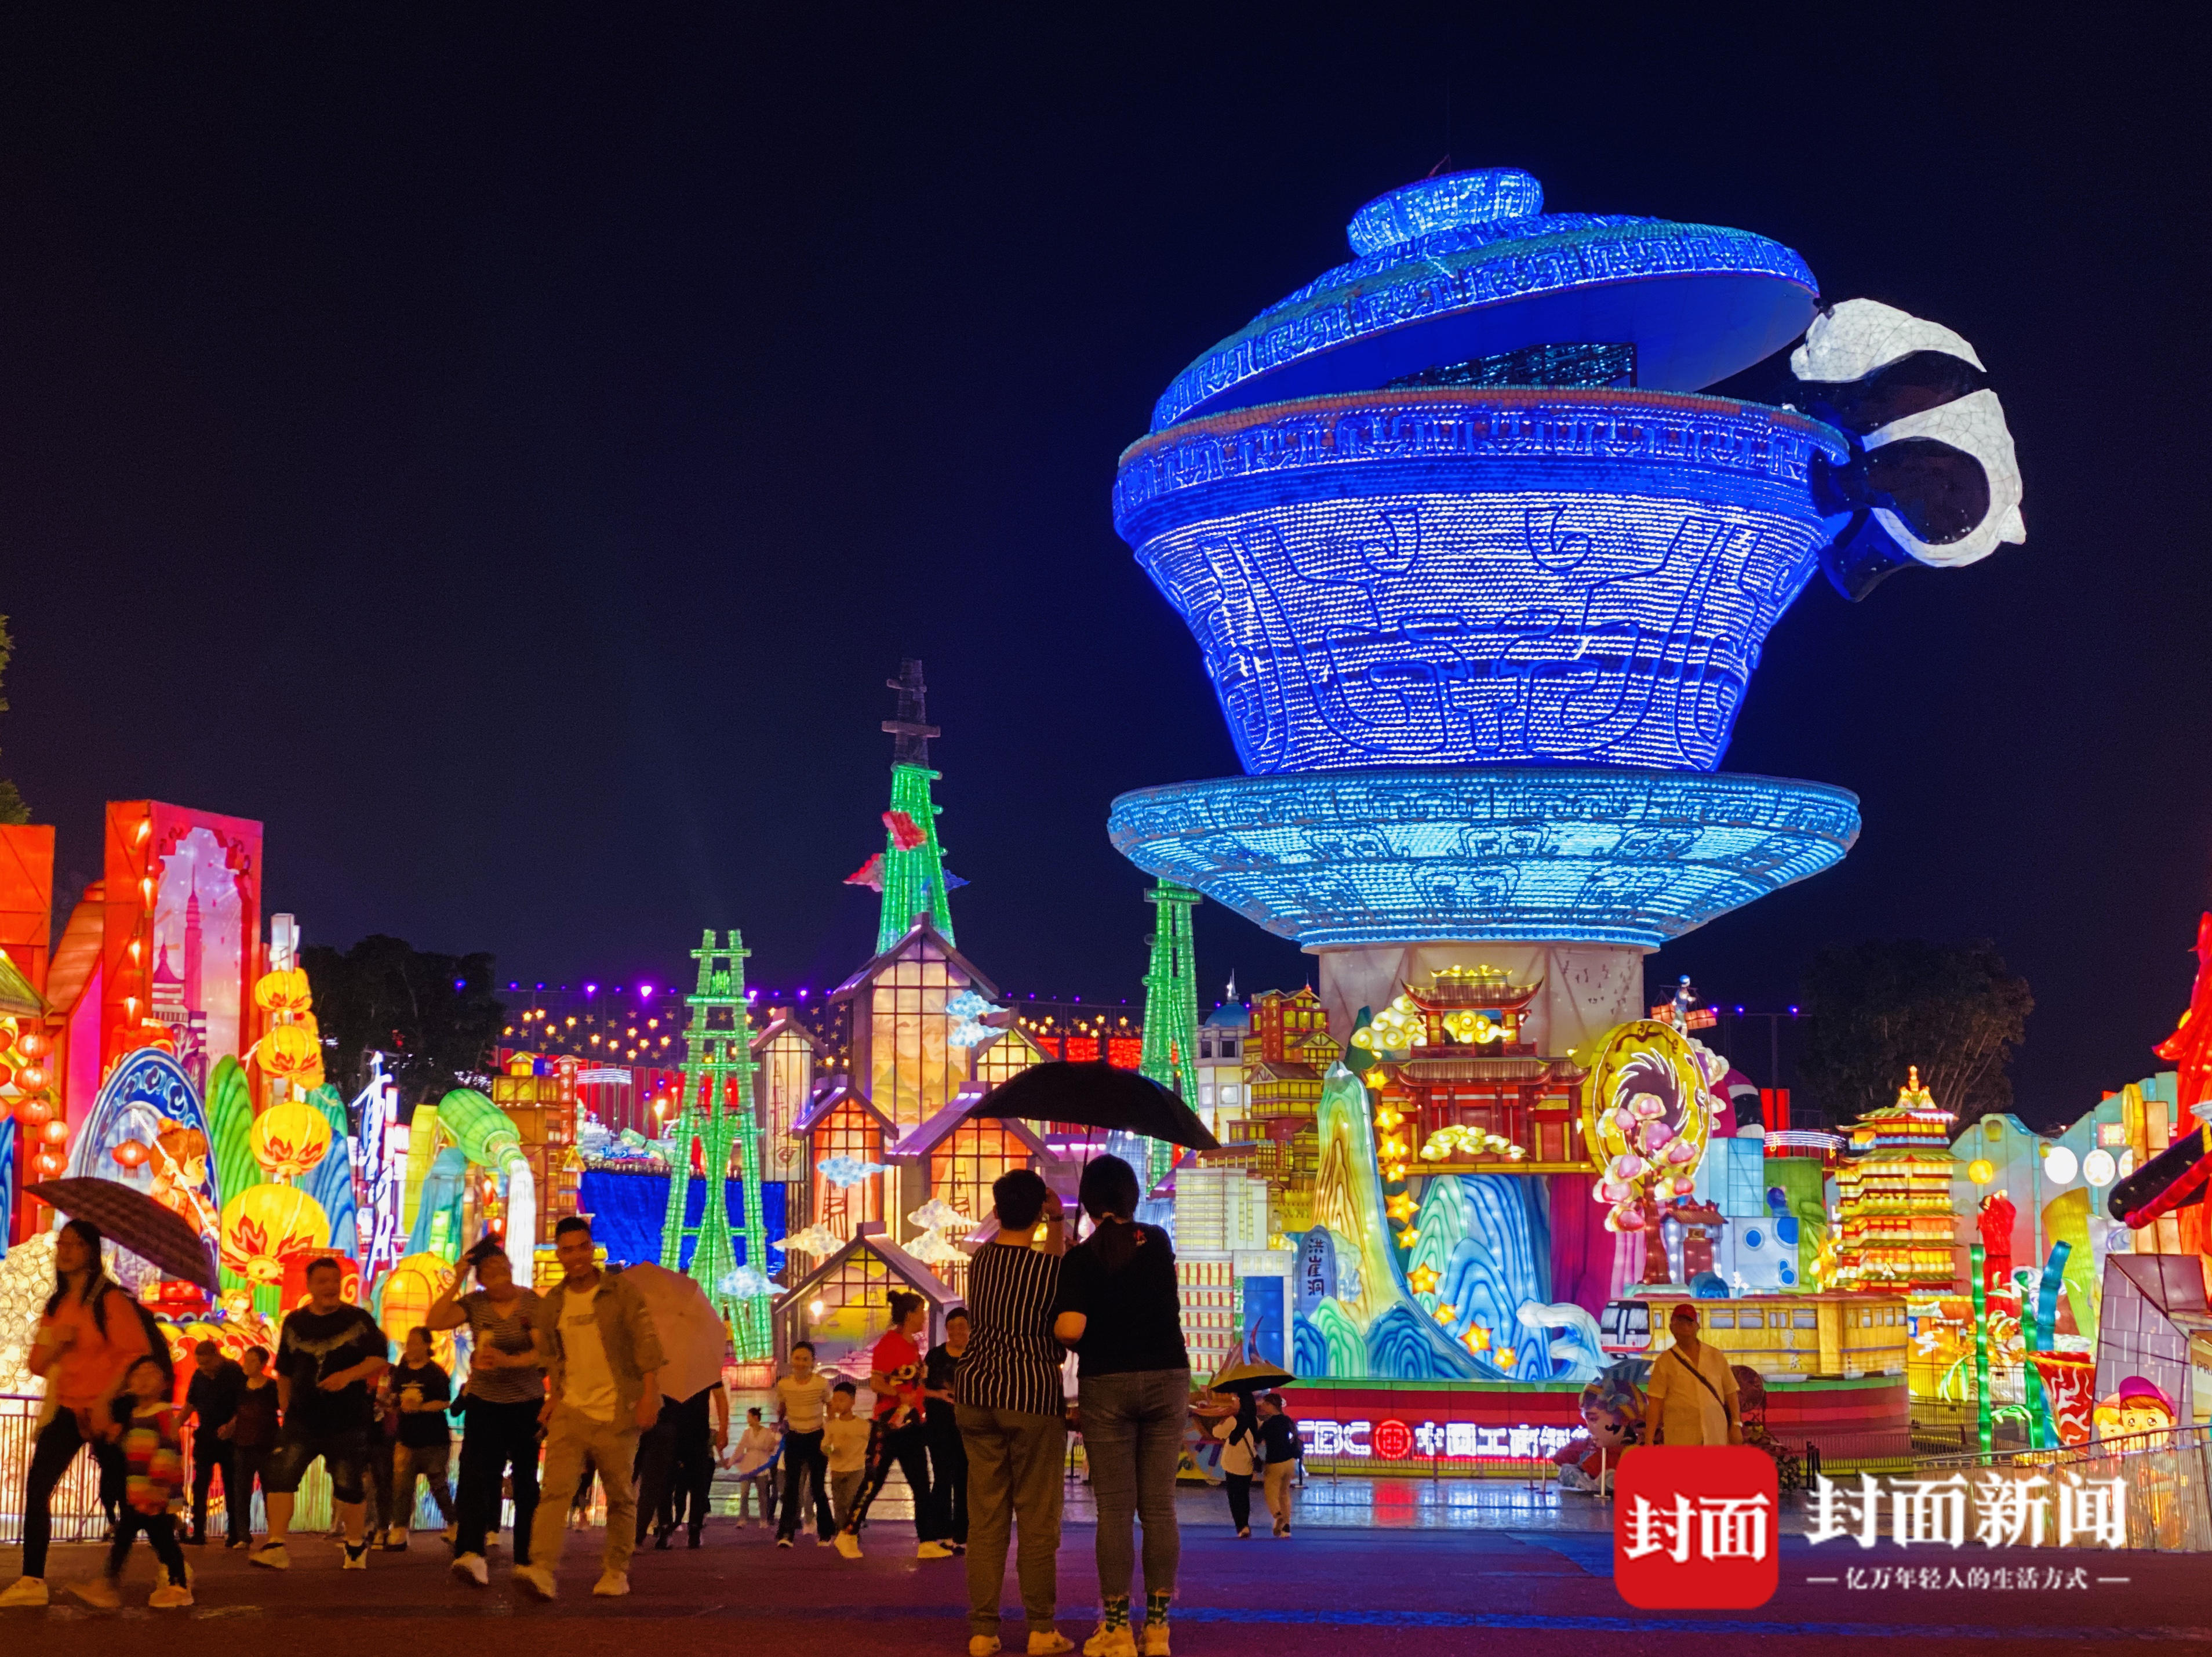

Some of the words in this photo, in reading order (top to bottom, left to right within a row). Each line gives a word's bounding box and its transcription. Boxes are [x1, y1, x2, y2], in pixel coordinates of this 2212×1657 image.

[1308, 1238, 1324, 1296] 洪崖洞
[2197, 1361, 2212, 1375] PR
[1297, 1420, 1371, 1455] CBC
